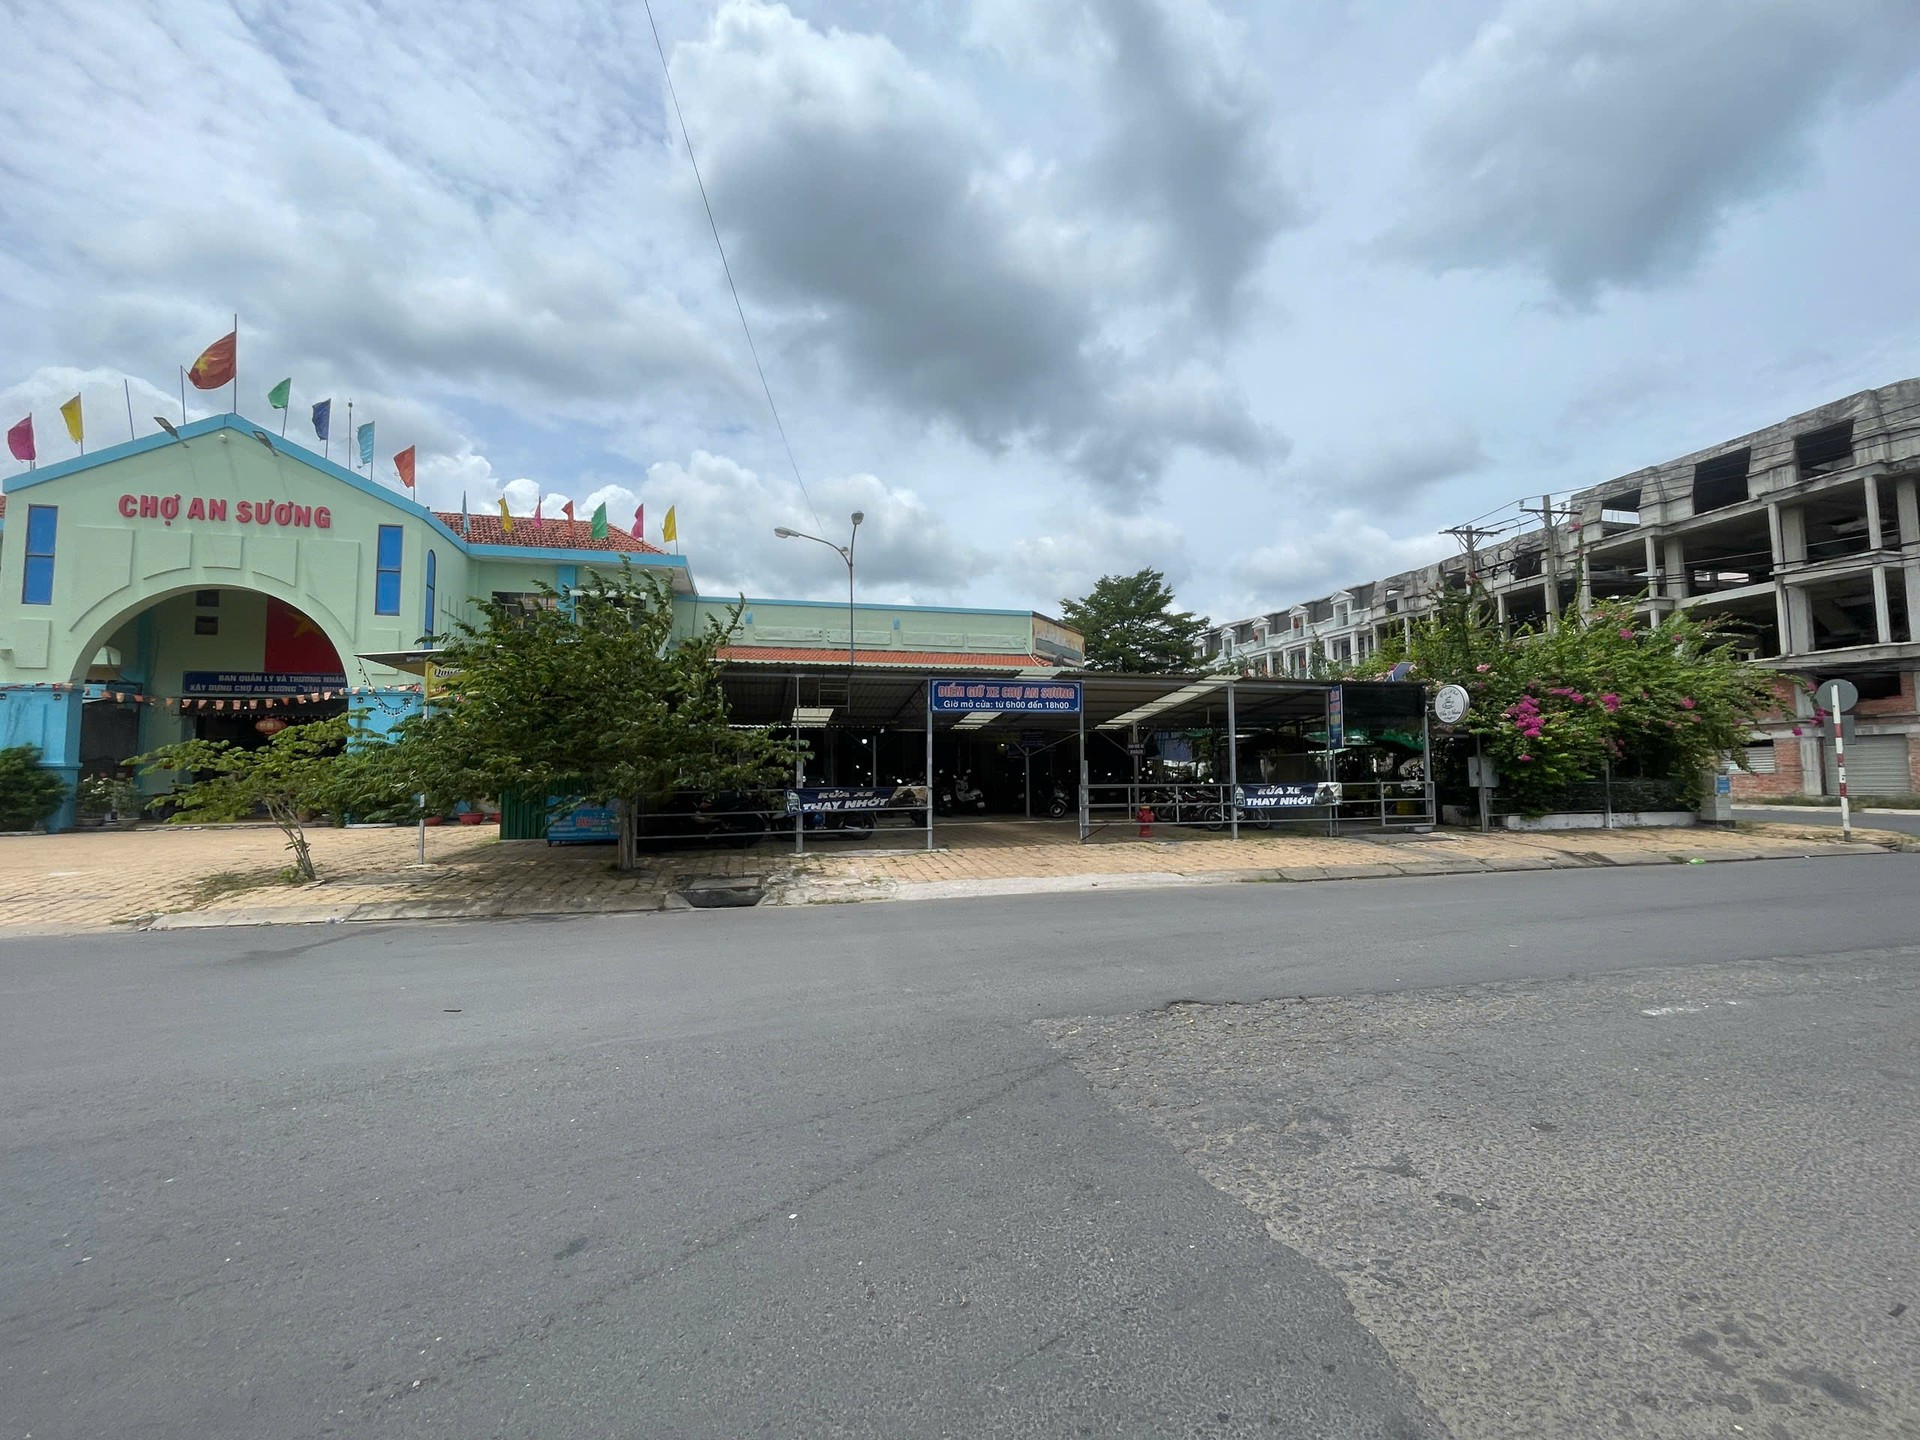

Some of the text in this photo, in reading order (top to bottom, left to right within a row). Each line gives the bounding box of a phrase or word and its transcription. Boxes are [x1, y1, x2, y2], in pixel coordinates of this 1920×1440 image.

[118, 493, 331, 528] CHỢ AN SƯƠNG
[218, 674, 237, 682] BAN
[234, 684, 252, 693] CHỢ
[253, 684, 266, 692] AN
[938, 682, 1075, 700] ĐIỂM GIỮ XE CHỢ AN SƯƠNG
[943, 700, 1070, 709] Giờ mở cửa: từ 6h00 đến 18h00
[817, 789, 850, 799] RỬA
[1257, 785, 1302, 795] RỬA XE
[802, 797, 889, 810] THAY NHỚT
[1246, 795, 1314, 805] THAY NHỚT
